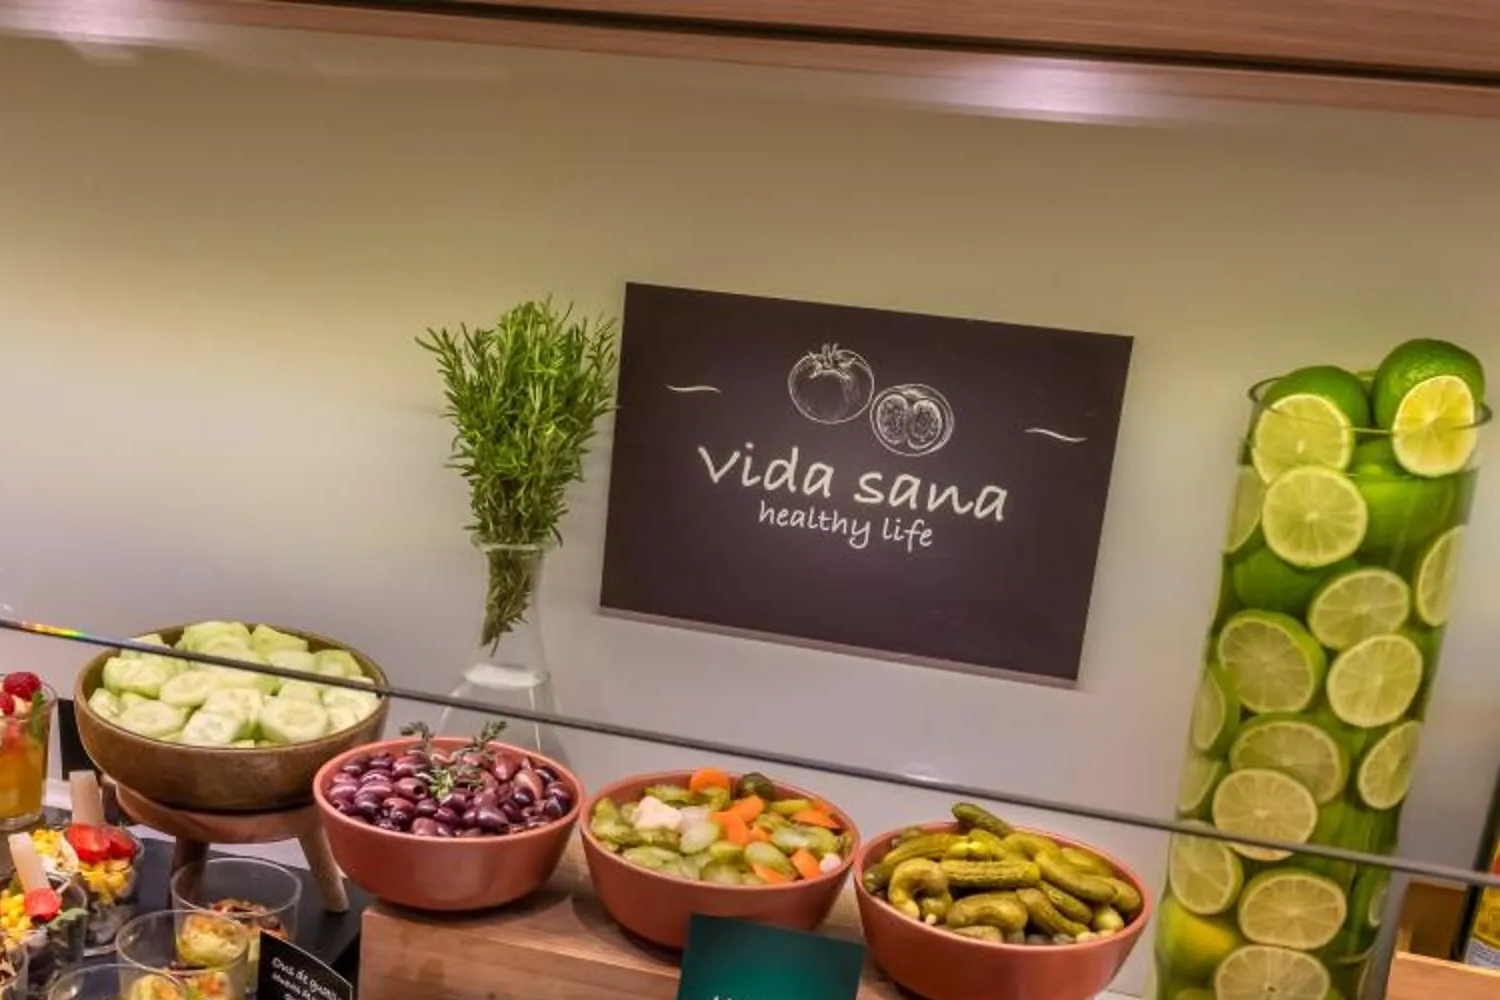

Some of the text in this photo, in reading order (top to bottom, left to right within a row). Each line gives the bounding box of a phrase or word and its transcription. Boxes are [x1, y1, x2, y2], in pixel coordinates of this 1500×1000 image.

[853, 471, 1008, 522] sana
[758, 500, 933, 552] healthy life
